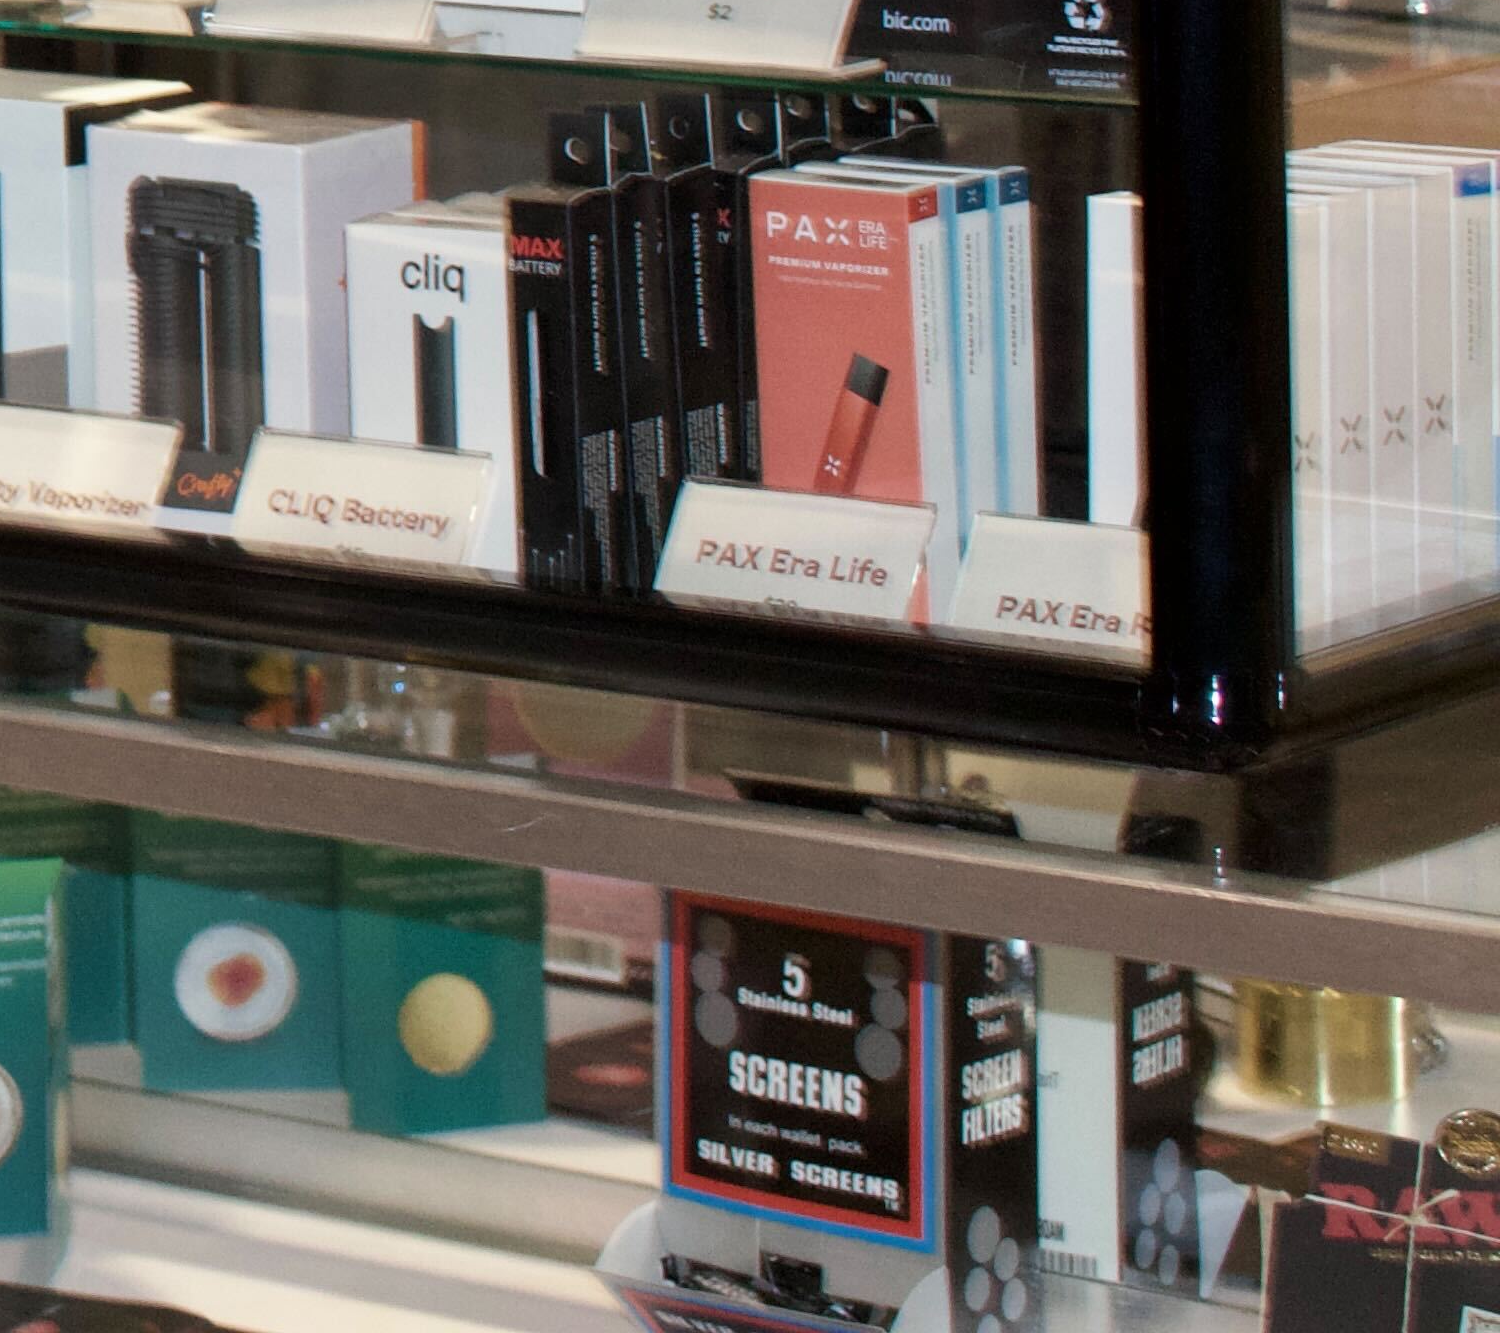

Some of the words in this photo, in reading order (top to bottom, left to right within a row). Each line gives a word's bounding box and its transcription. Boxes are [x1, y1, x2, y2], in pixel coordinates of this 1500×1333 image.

[707, 3, 733, 20] $2
[882, 8, 951, 33] bic.com
[509, 234, 564, 258] MAX
[765, 210, 850, 247] PAX
[857, 219, 887, 235] ERA
[859, 235, 888, 251] LIFE
[400, 253, 465, 303] cliq
[508, 259, 563, 276] BATTERY
[768, 254, 822, 270] PREMIUM
[824, 260, 890, 277] VAPORIZER
[27, 479, 151, 518] Vaporizer
[267, 488, 335, 524] CLIQ
[341, 497, 450, 538] Battery
[695, 538, 764, 570] PAX
[768, 547, 821, 579] Era
[828, 554, 889, 587] Life
[995, 595, 1065, 626] PAX
[1068, 603, 1122, 634] Era
[781, 952, 808, 999] 5
[984, 943, 1007, 983] 5
[736, 986, 809, 1018] Stainless
[811, 1000, 854, 1026] Steel
[728, 1049, 865, 1119] SCREENS
[961, 1048, 1022, 1100] SCREEN
[743, 1116, 778, 1136] each
[961, 1093, 1023, 1145] FILTERS
[697, 1137, 775, 1175] SILVER
[789, 1160, 900, 1201] SCREENS
